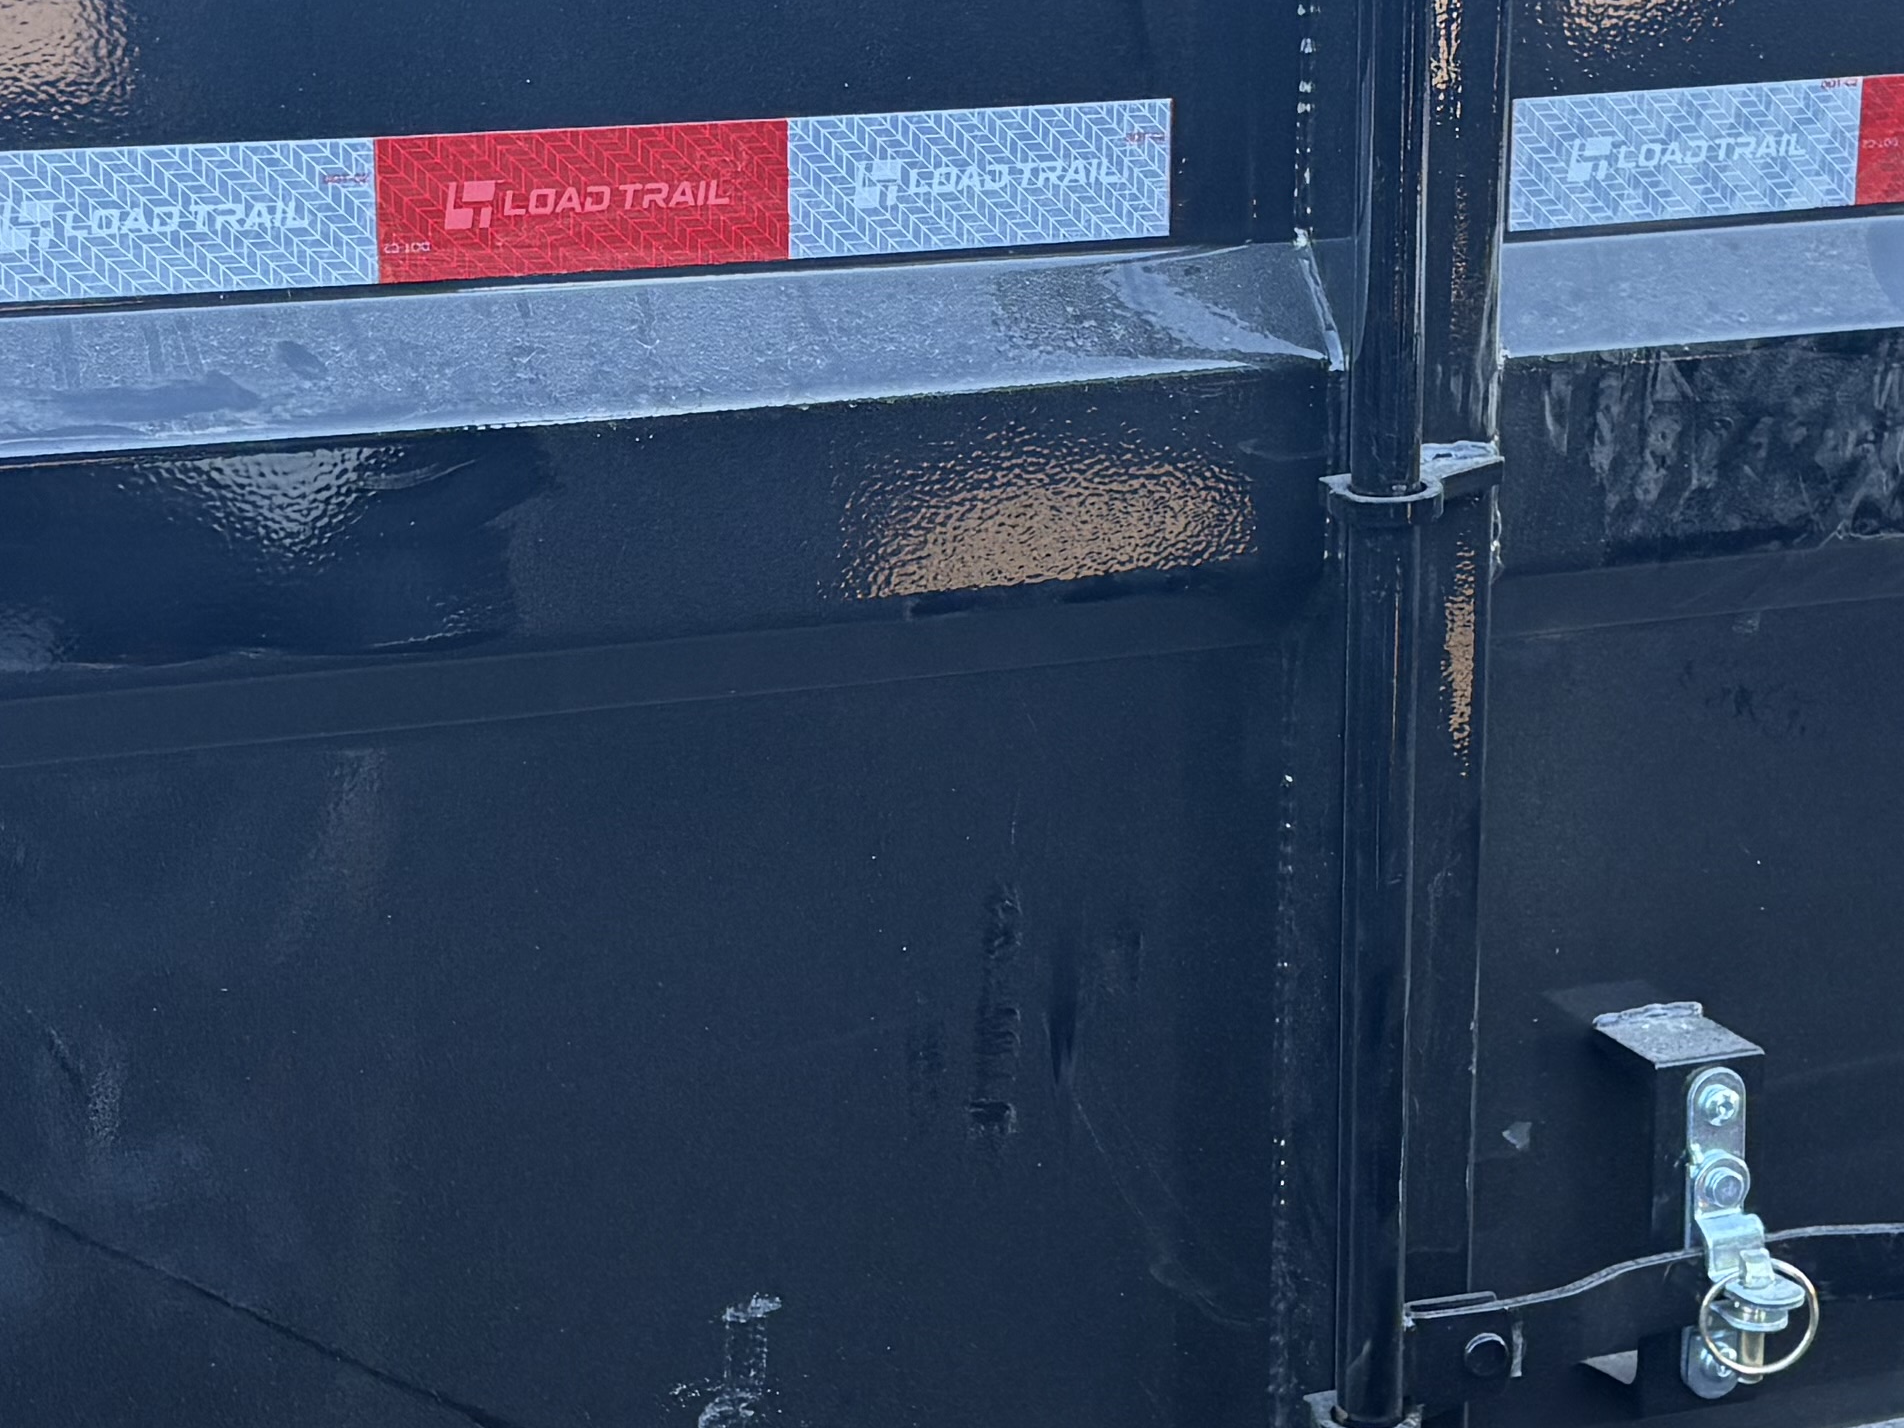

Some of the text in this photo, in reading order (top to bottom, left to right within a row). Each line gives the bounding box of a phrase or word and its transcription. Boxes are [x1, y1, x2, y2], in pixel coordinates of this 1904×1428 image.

[1617, 133, 1810, 169] LOAD TRAIL
[906, 158, 1130, 196] LOAD TRAIL
[502, 178, 732, 217] LOAD TRAIL
[62, 200, 310, 238] LOAD TRAIL
